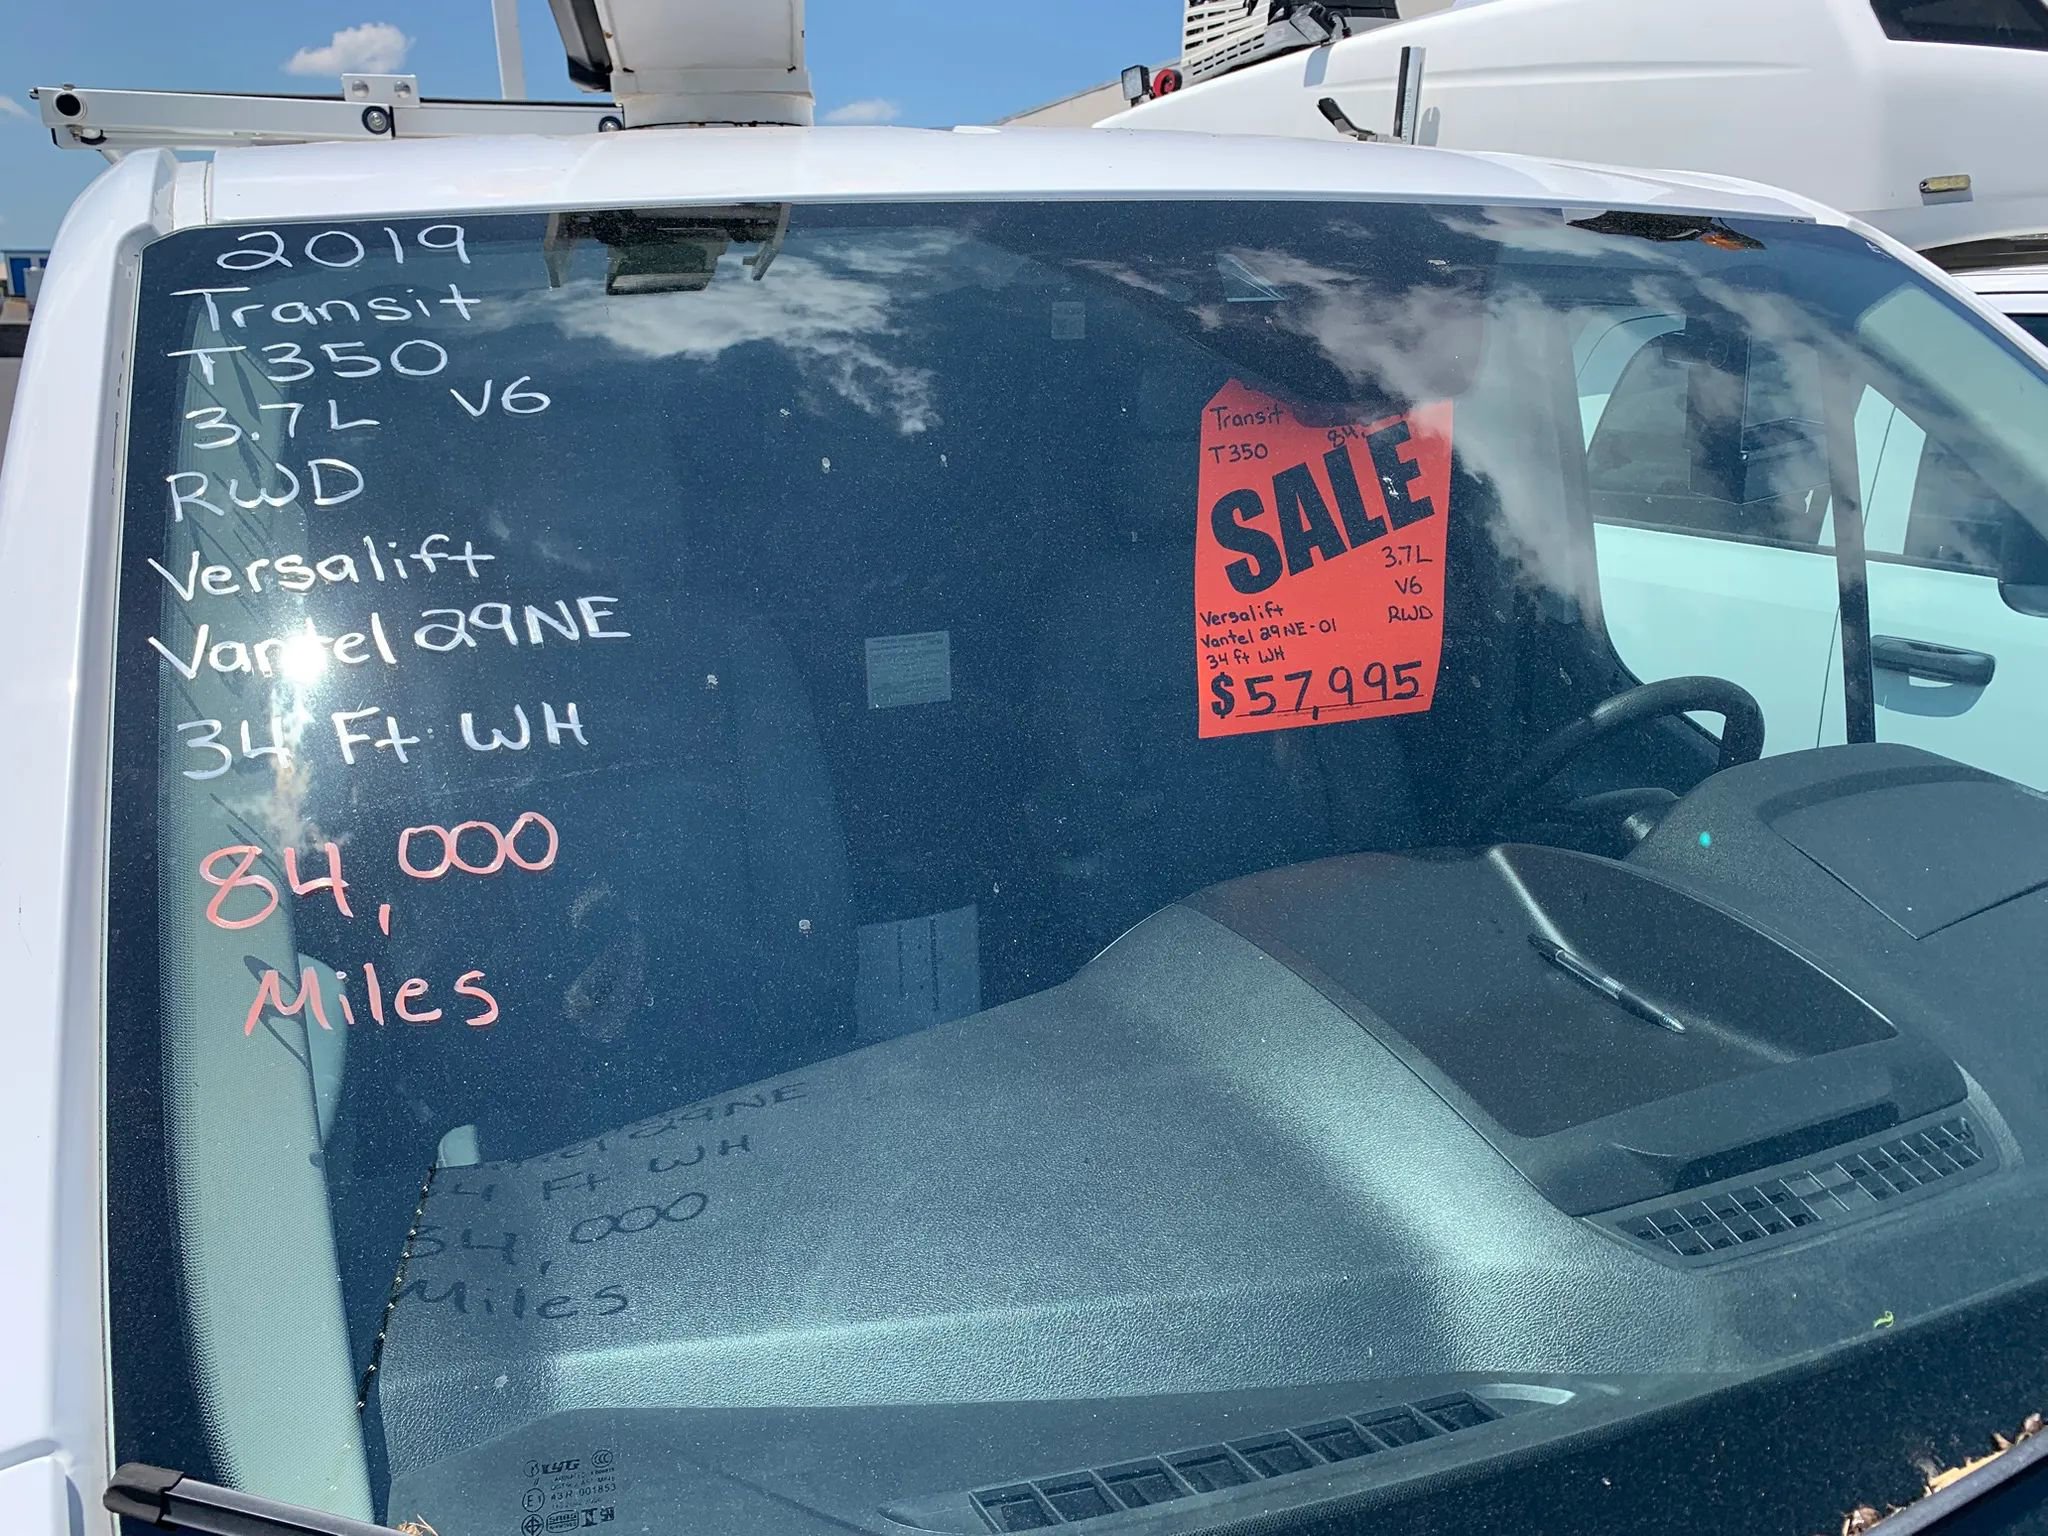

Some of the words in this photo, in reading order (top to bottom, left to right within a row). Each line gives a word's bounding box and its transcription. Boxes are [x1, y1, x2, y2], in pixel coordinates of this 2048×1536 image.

[216, 225, 470, 271] 2019
[170, 284, 481, 332] Transit
[167, 339, 448, 385] T350
[451, 376, 550, 417] V6
[1210, 403, 1283, 431] Transit
[186, 400, 380, 449] 3.7L
[1208, 443, 1269, 465] T350
[166, 458, 365, 522] RWD
[1211, 420, 1435, 594] SALE
[148, 534, 495, 602] Versalift
[1381, 544, 1433, 568] 3.7L
[1395, 576, 1423, 595] V6
[1200, 601, 1284, 627] Versalift
[1388, 605, 1434, 624] RWD
[148, 612, 397, 680] Vantel
[414, 597, 631, 651] 29NE
[1200, 629, 1255, 650] Vantel
[1206, 653, 1230, 670] 34
[1258, 646, 1285, 664] WH
[1210, 660, 1423, 721] $57,995
[176, 718, 293, 781] 34
[460, 702, 588, 751] WH
[200, 811, 558, 936] 84,000
[244, 962, 500, 1036] Miles
[650, 1134, 751, 1174] WH
[395, 1278, 629, 1320] Miles
